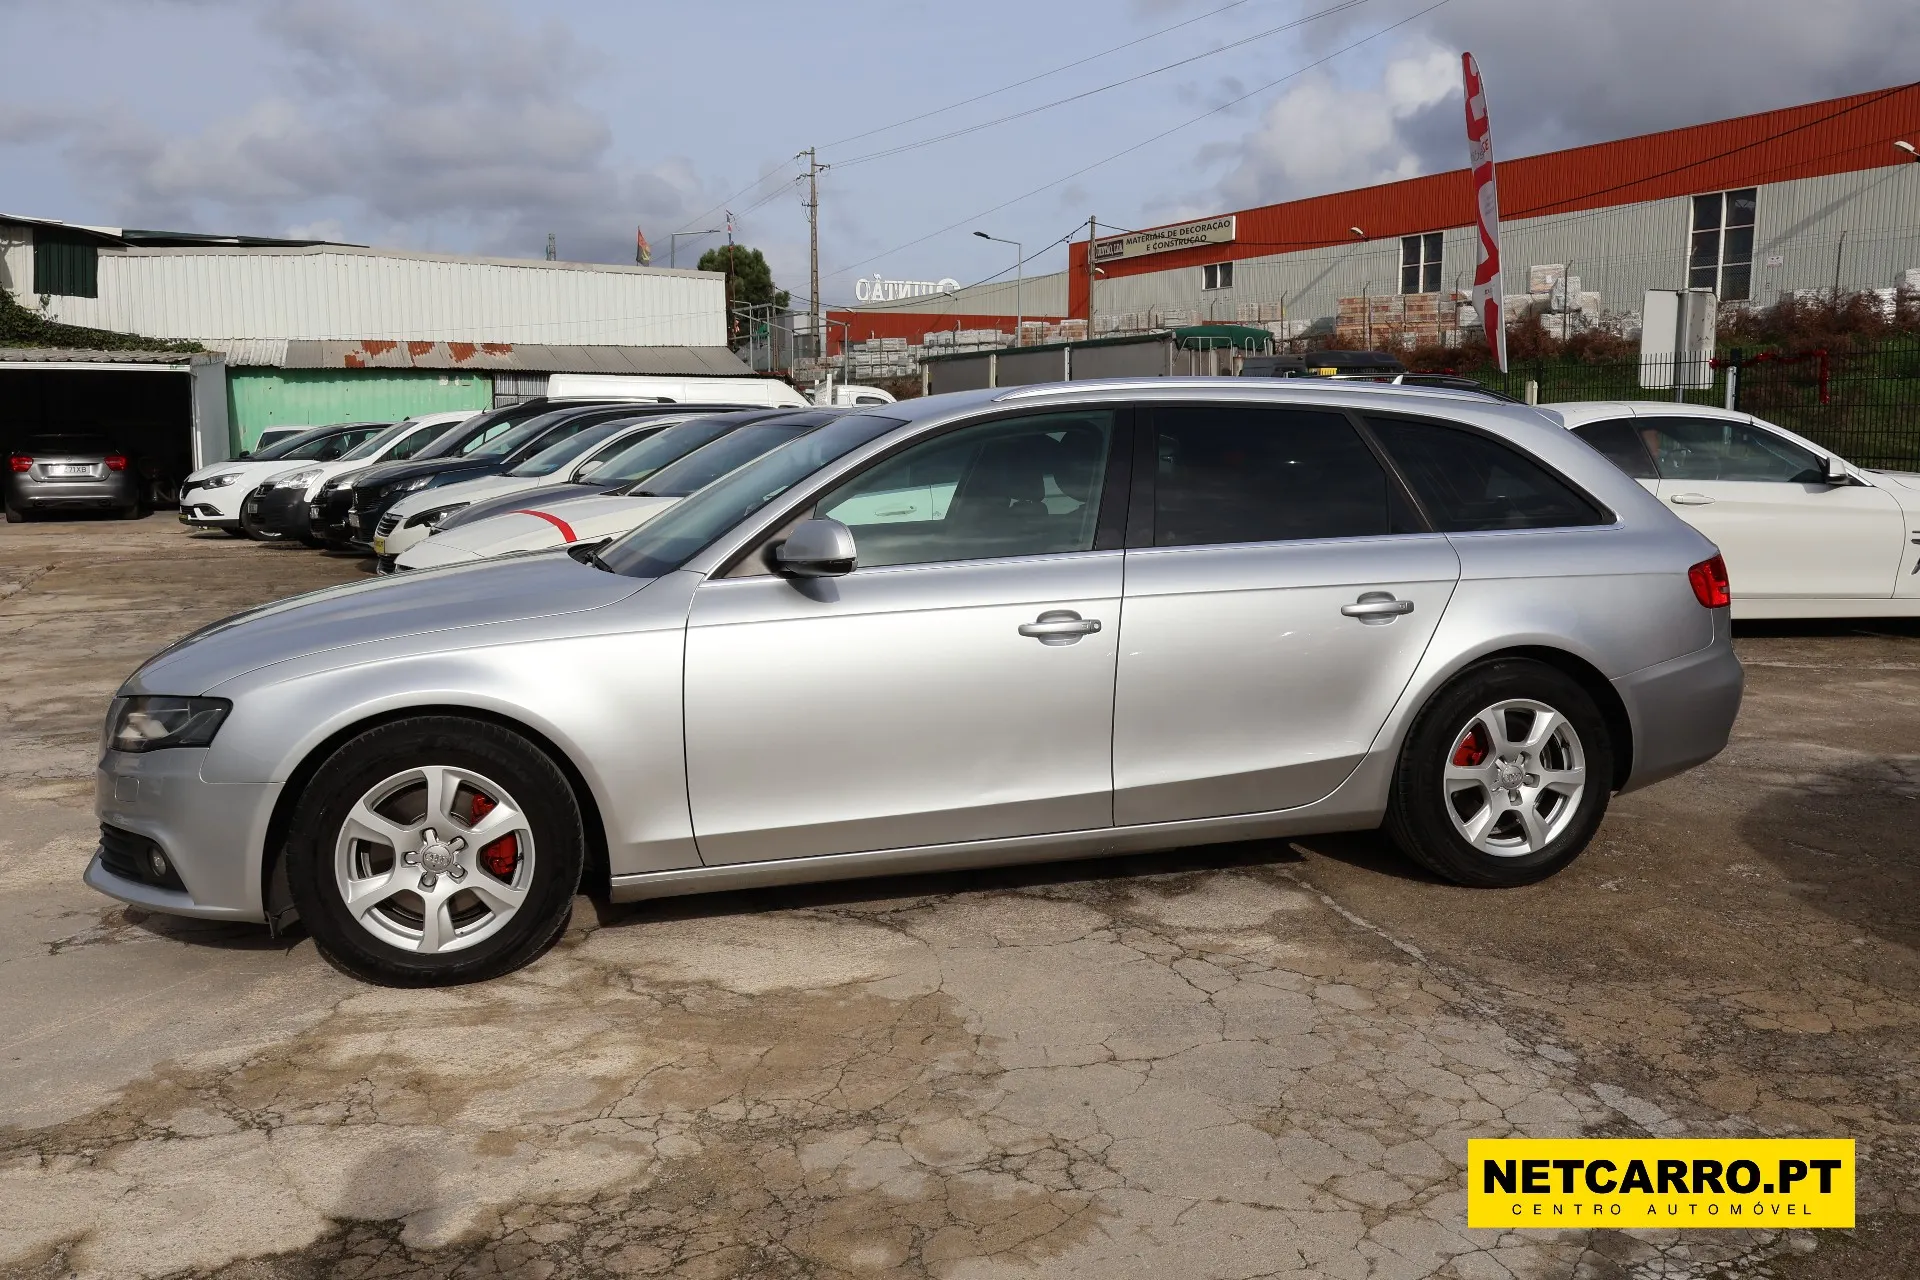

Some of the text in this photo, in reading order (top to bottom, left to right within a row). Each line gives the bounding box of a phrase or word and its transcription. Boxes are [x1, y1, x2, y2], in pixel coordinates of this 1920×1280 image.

[1126, 219, 1231, 245] MATERIAIS DE DECORAÇÃO
[1152, 234, 1207, 250] CONSTRUÇÃO
